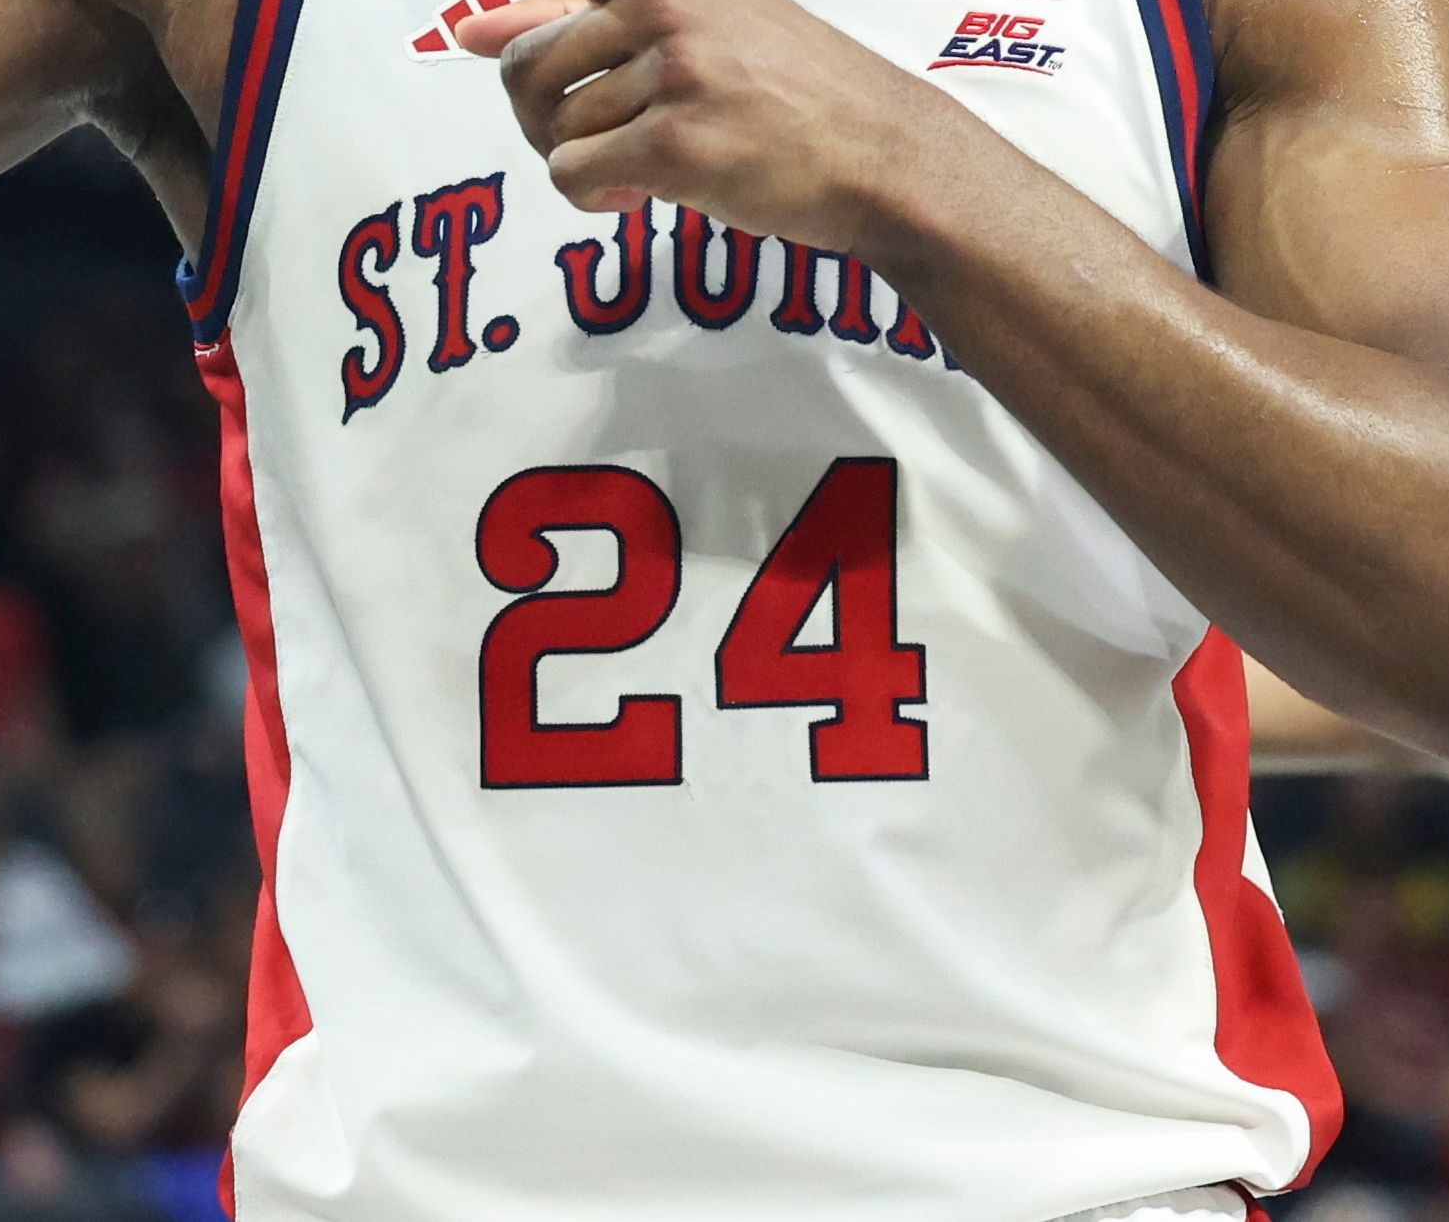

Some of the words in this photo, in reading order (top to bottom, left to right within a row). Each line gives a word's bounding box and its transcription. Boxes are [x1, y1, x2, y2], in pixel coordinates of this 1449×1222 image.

[938, 36, 1066, 68] EAST
[955, 11, 1046, 40] BIG
[338, 171, 521, 426] ST.
[475, 456, 929, 789] 24
